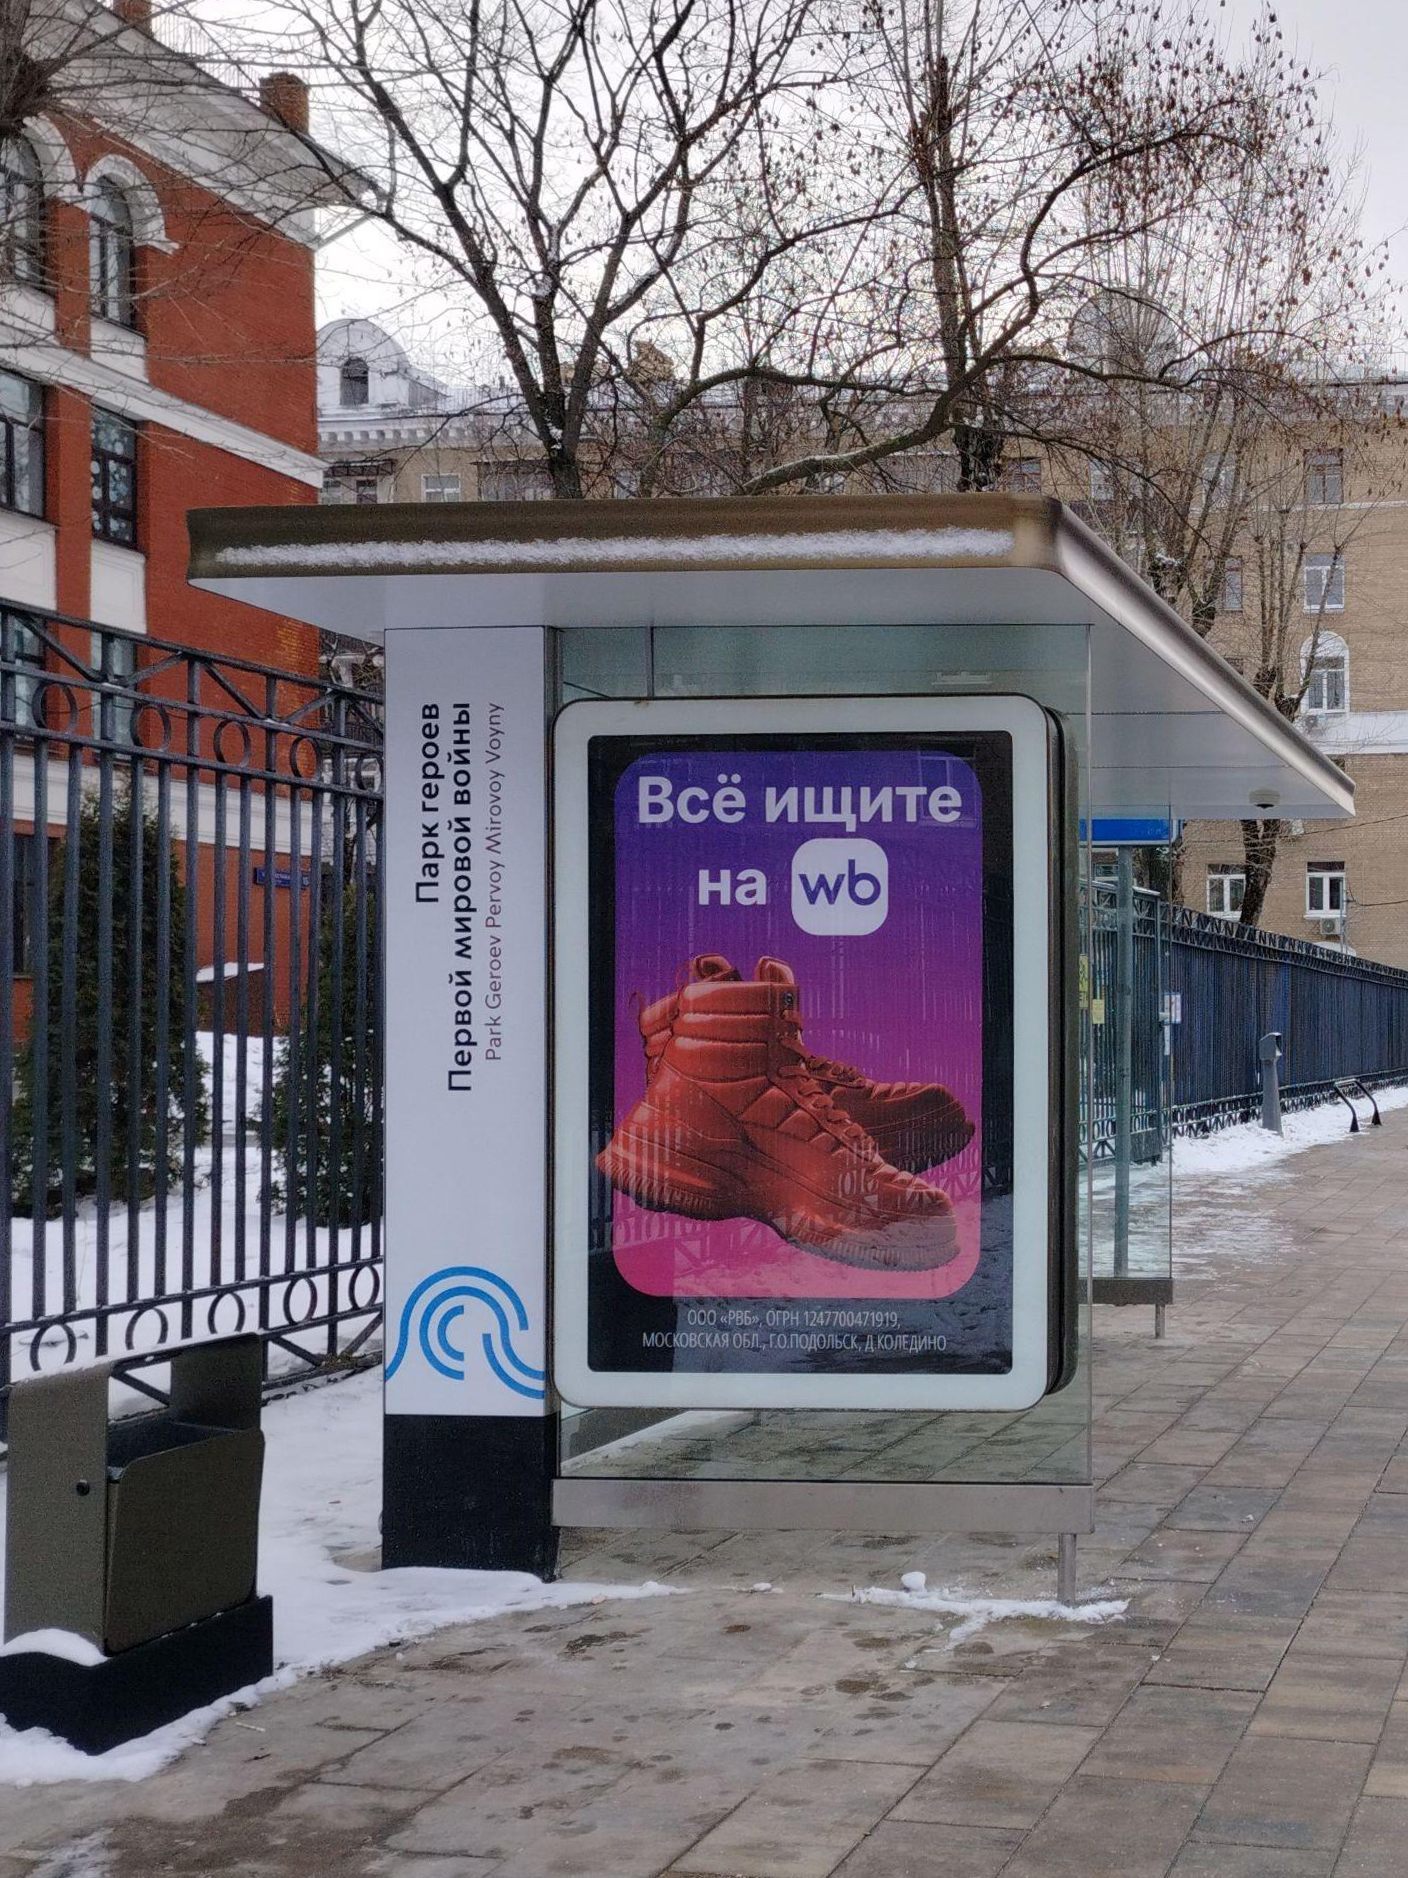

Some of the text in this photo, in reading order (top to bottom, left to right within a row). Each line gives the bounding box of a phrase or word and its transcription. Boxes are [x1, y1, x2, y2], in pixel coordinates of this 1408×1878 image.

[416, 703, 444, 902] Парк героев
[637, 773, 963, 832] Всё ищите
[447, 703, 477, 1091] Первой мировой войны
[485, 703, 505, 1061] Park Geroev Pervoy Mirovoy Voyny
[698, 859, 881, 905] на wb
[642, 1332, 729, 1348] МОСКОВСКАЯ
[732, 1333, 767, 1350] ОБЛ.,
[687, 1309, 901, 1329] ООО «РВБ», ОГРН 1247700471919,
